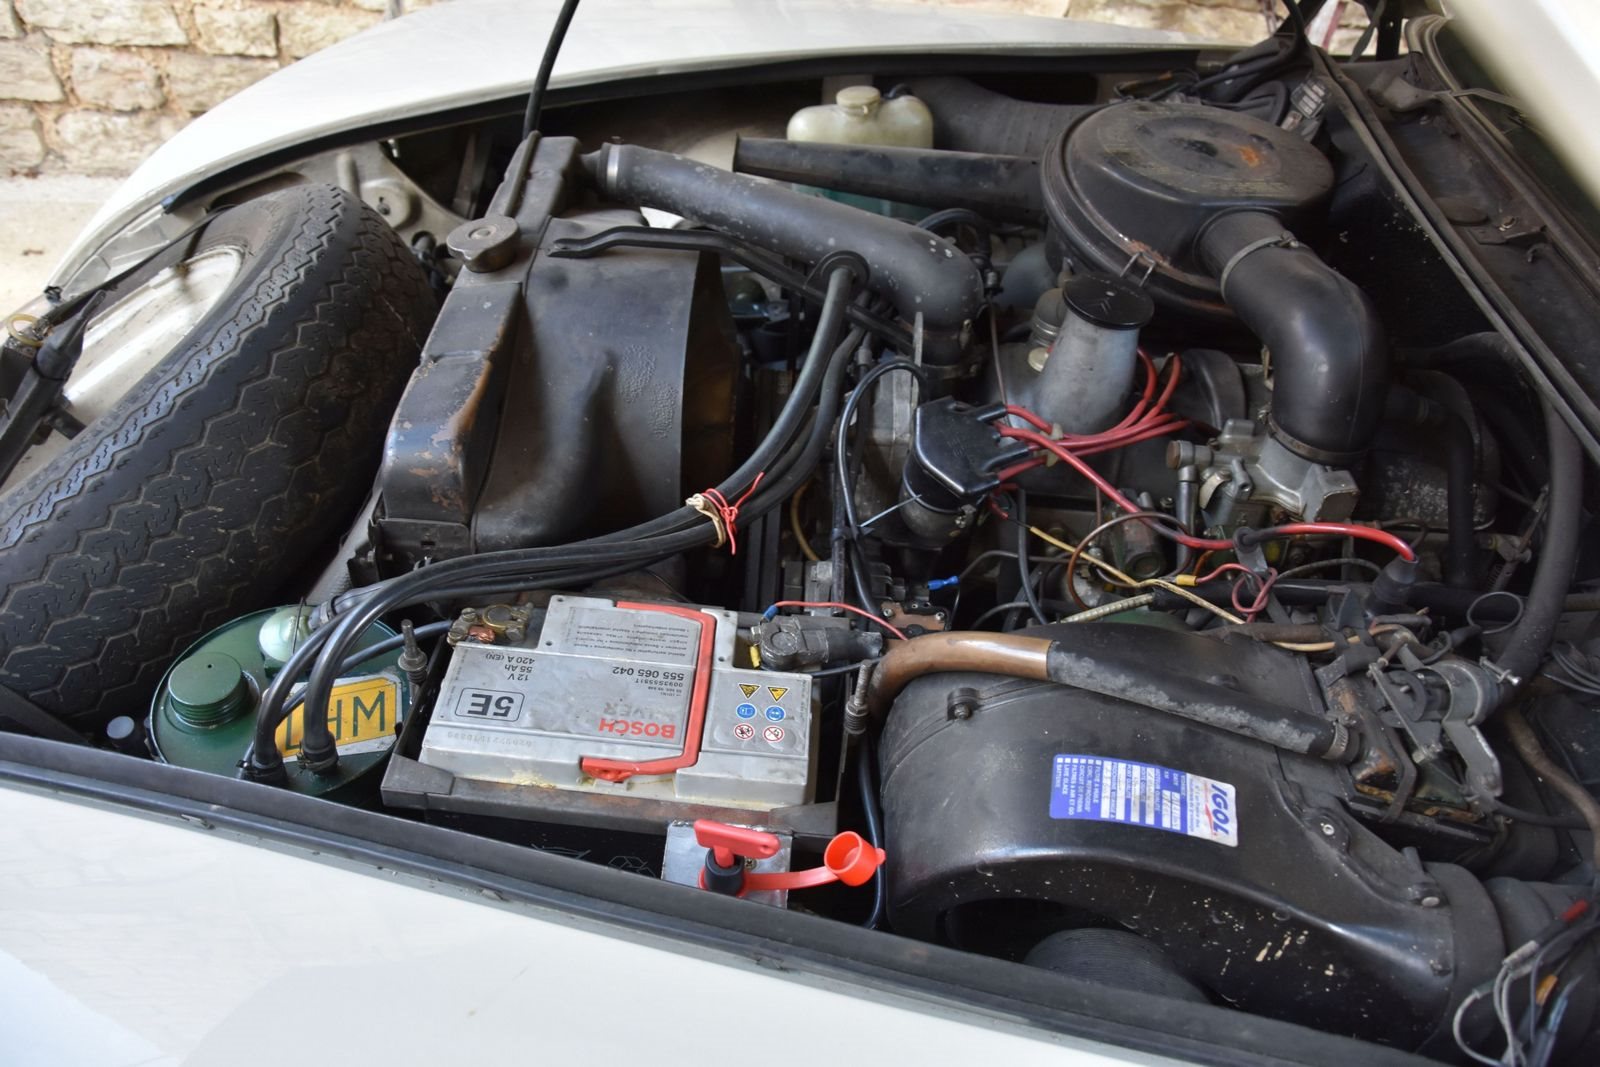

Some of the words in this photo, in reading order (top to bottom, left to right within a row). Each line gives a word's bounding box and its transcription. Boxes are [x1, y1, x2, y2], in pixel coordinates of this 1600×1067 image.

[485, 652, 505, 661] (EN)
[507, 655, 514, 663] A
[516, 656, 535, 665] 420
[505, 664, 517, 672] Ah
[612, 666, 634, 676] 042
[517, 673, 529, 681] 12
[637, 669, 660, 678] 065
[663, 671, 685, 681] 555
[467, 693, 514, 718] 5E
[598, 717, 676, 739] BOSCH
[1211, 783, 1230, 835] IGOL
